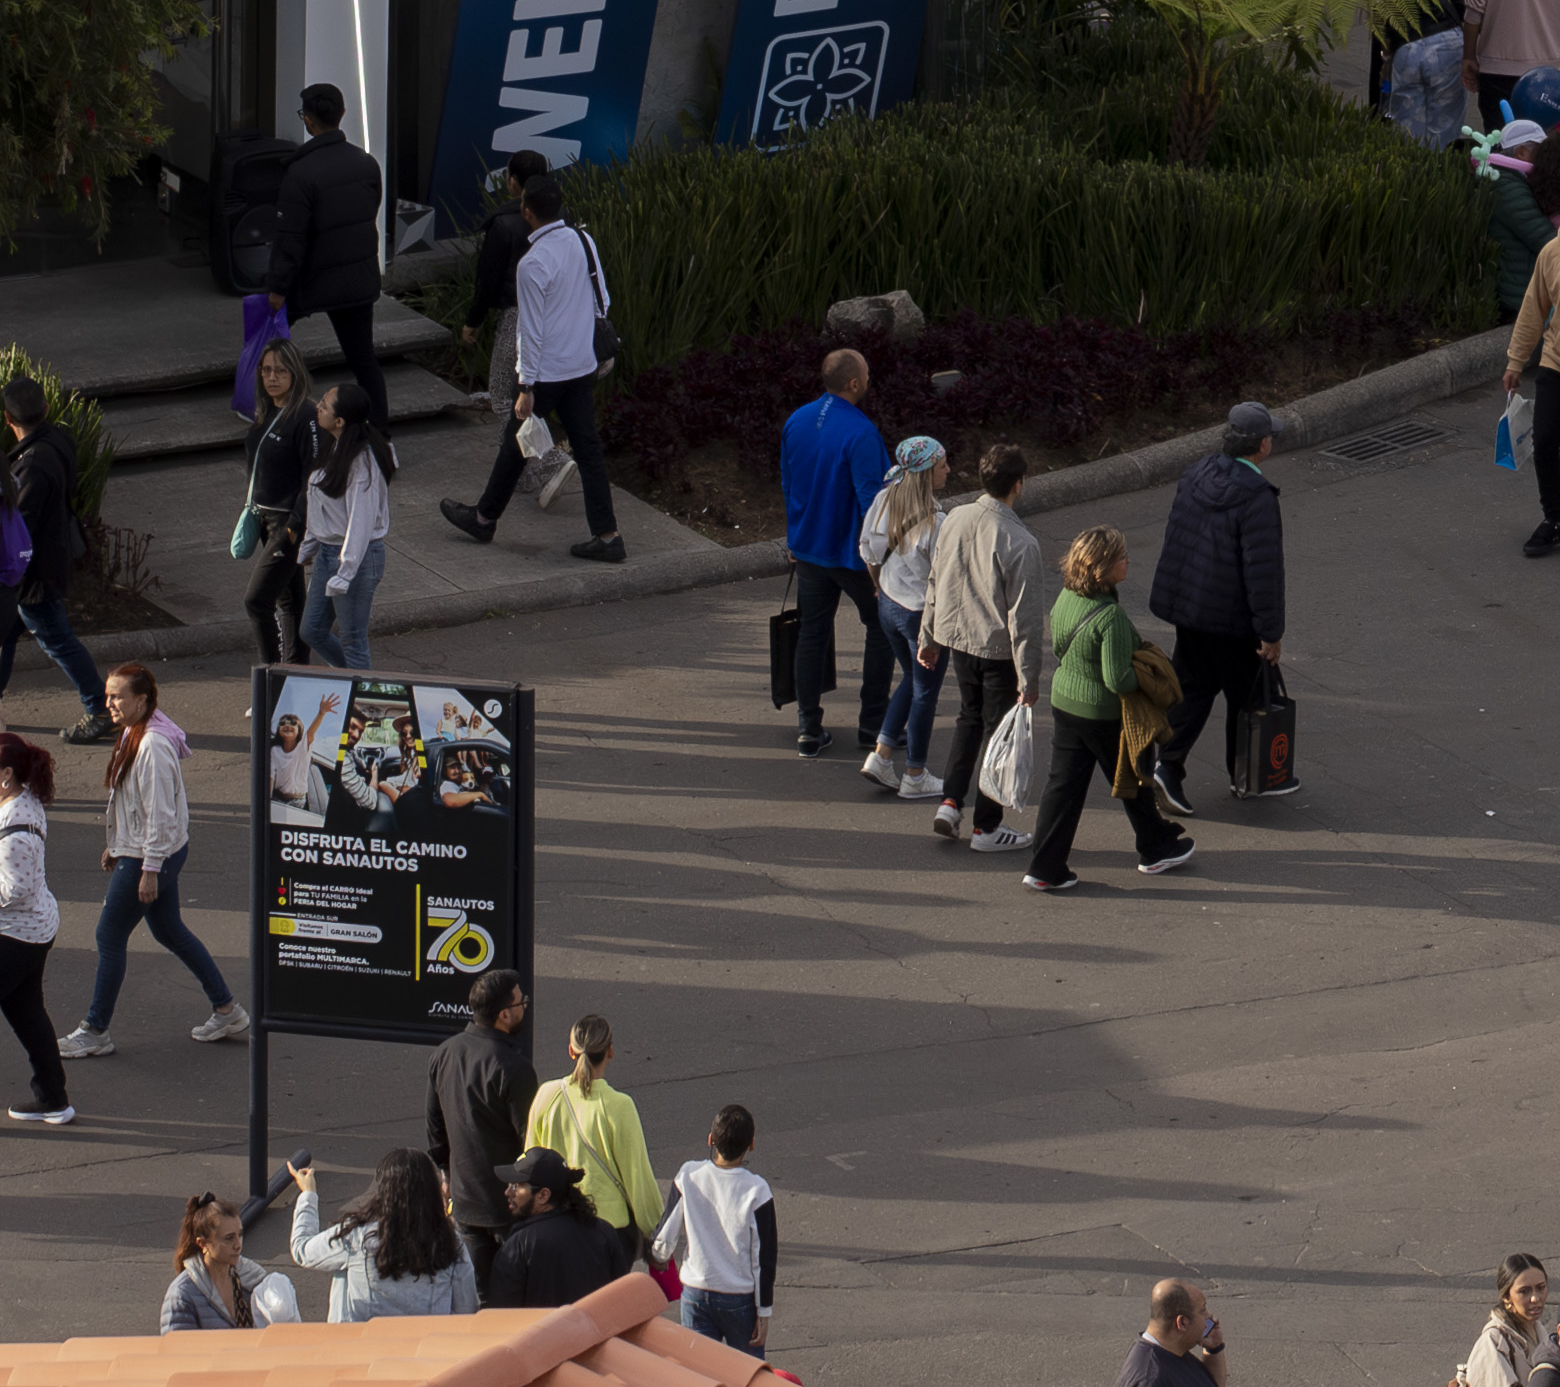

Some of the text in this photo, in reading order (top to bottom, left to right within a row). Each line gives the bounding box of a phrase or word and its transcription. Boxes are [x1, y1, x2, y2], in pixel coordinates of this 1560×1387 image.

[281, 831, 467, 860] DISFRUTA EL CAMINO
[281, 848, 418, 872] CON SANAUTOS
[294, 882, 354, 893] Compra CARRO
[322, 892, 349, 901] FAMILIA
[294, 899, 314, 907] FERIA
[331, 901, 357, 909] HOGAR
[427, 896, 494, 910] SANAUTOS
[331, 929, 377, 938] GRAN SALÓN
[279, 943, 336, 954] Conoce nuestro
[279, 951, 369, 965] portafolio MULTIMARCA.
[427, 963, 454, 975] Años
